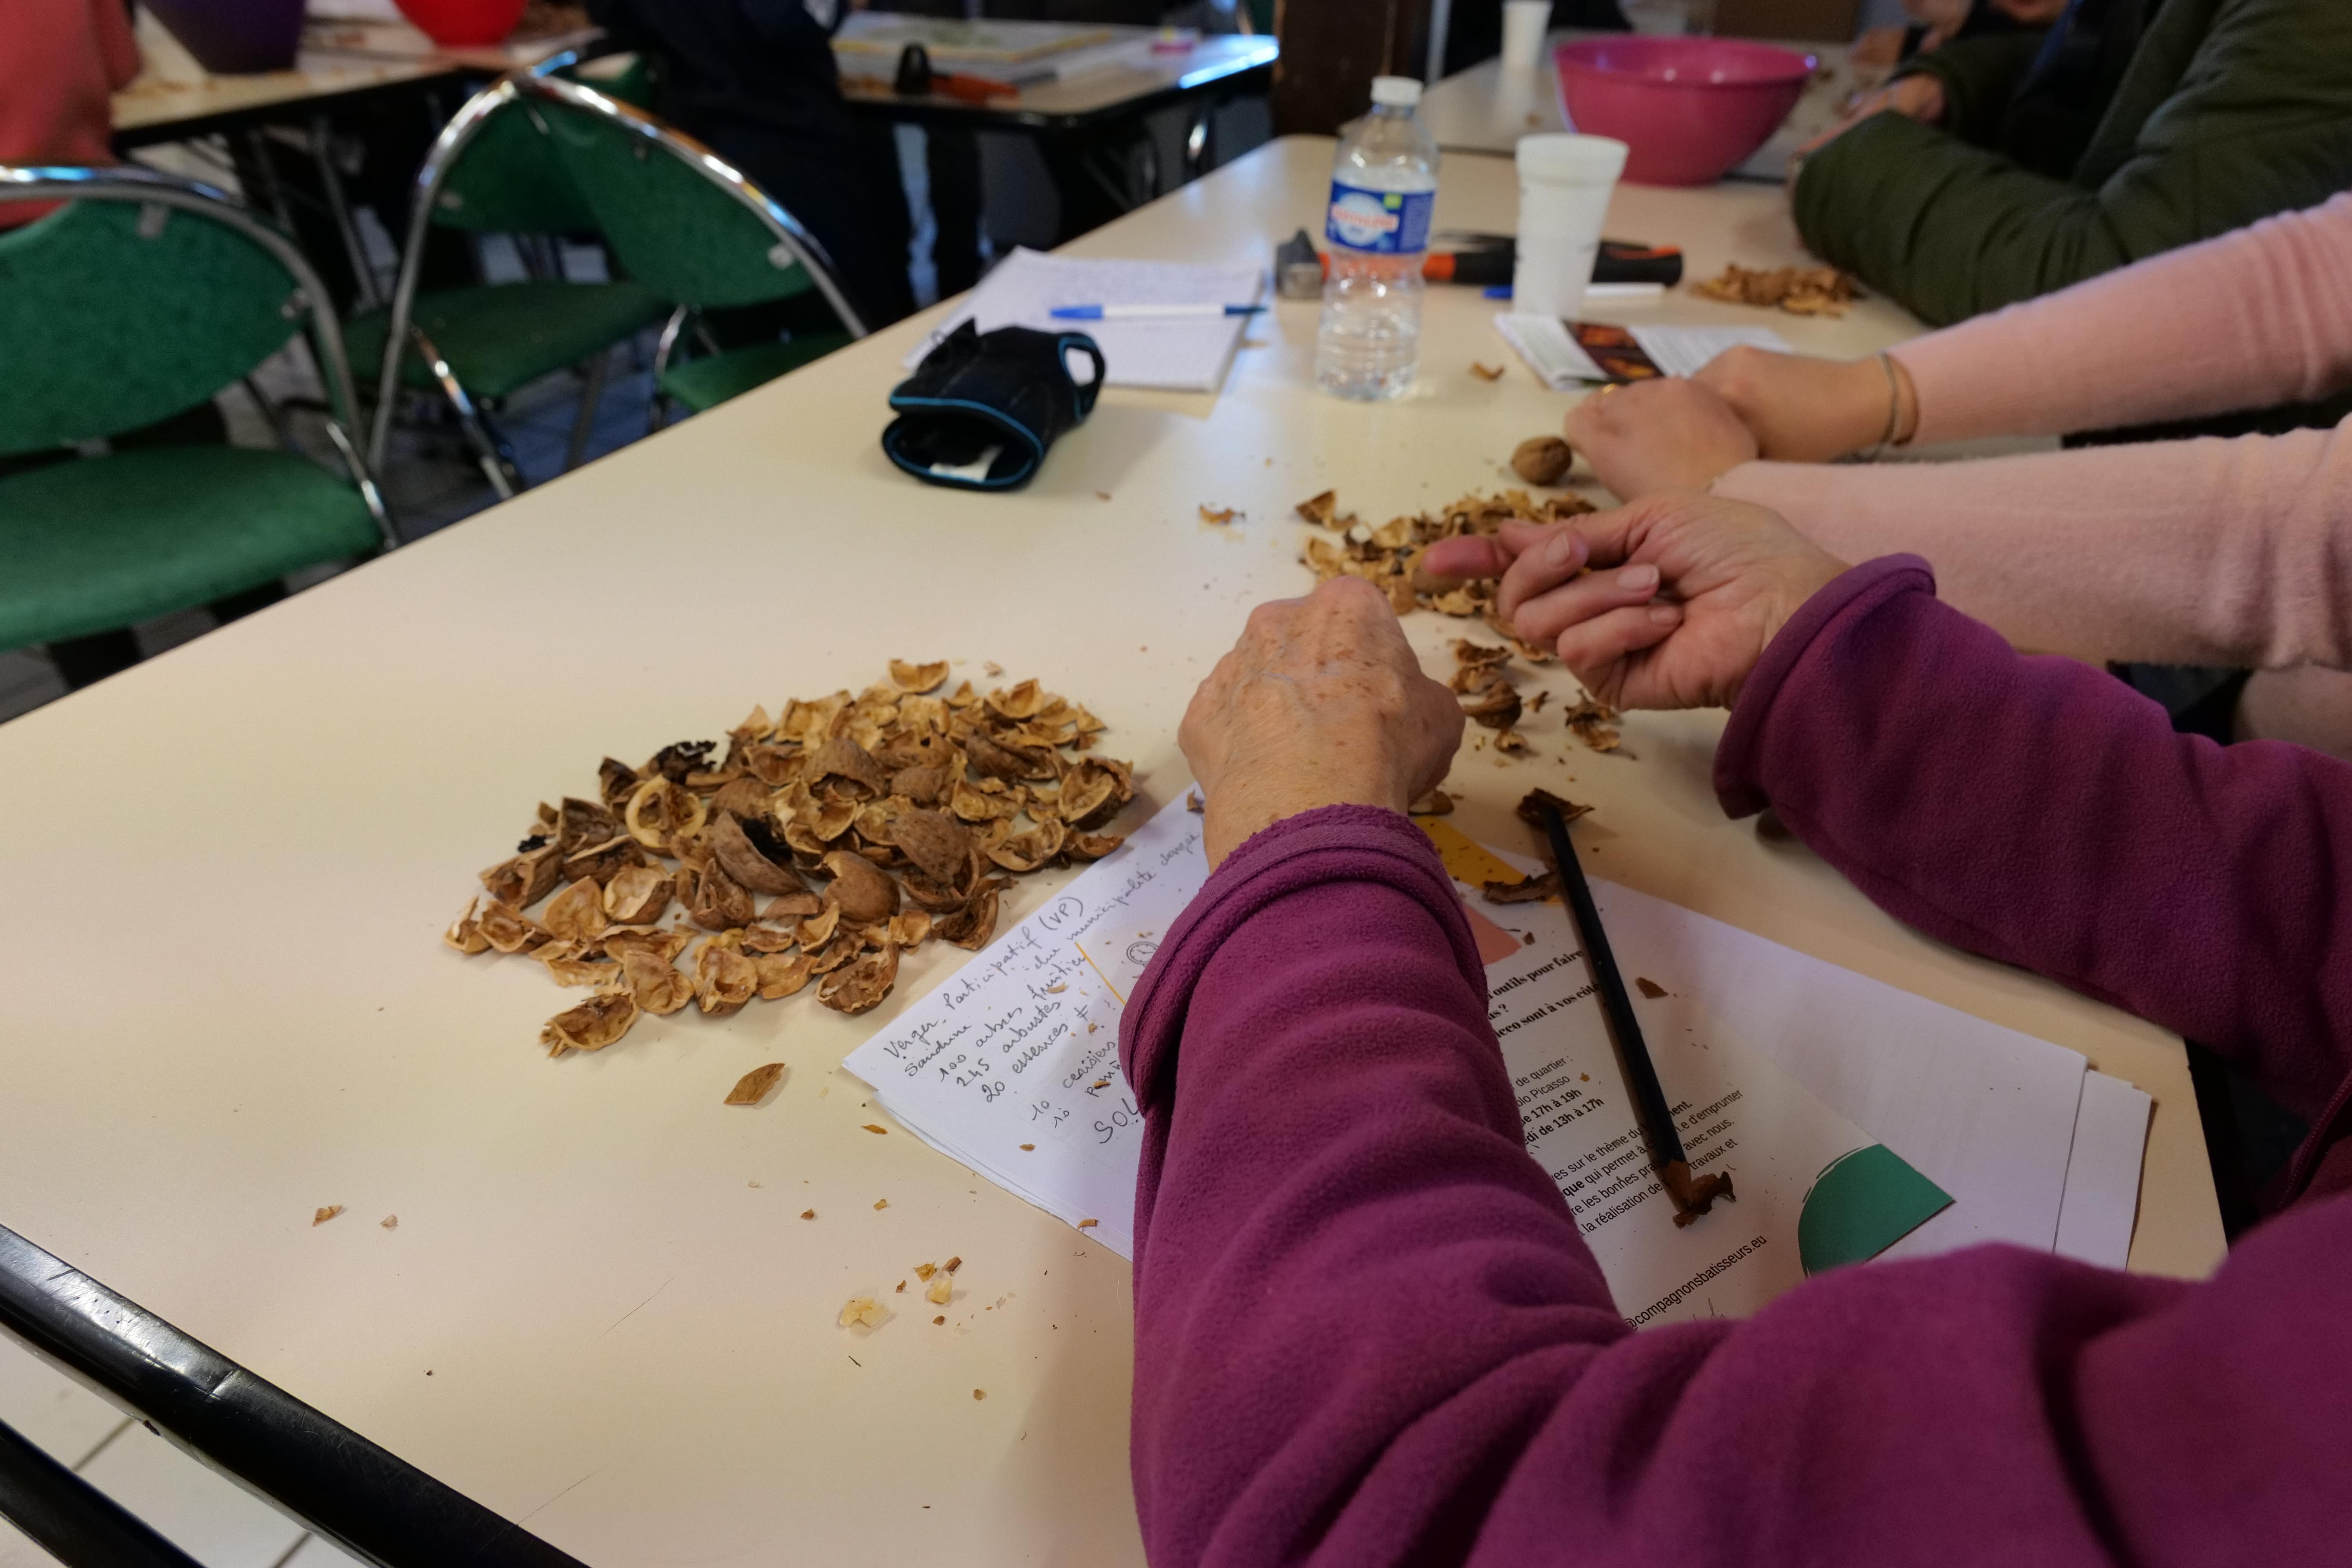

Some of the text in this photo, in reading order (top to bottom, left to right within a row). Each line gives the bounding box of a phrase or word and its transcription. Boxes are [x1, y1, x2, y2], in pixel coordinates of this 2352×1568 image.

[883, 897, 1083, 1058] Verger Participatif (VP)
[1493, 976, 1528, 996] outils
[1526, 963, 1555, 982] pour
[1553, 950, 1584, 966] faire
[1498, 1003, 1509, 1013] ?
[1520, 1007, 1549, 1025] sont
[1544, 1003, 1557, 1013] à
[1555, 995, 1577, 1008] vos
[904, 1025, 973, 1077] Sandrine
[940, 1054, 967, 1083] 100
[976, 1007, 1022, 1048] arbres
[956, 1001, 1061, 1087] 245 arbustes
[982, 1081, 1005, 1103] 20
[1012, 1023, 1069, 1074] essences
[1032, 1041, 1116, 1121] 10 cerisiers
[1515, 1076, 1530, 1087] de
[1530, 1058, 1566, 1080] quartier
[1530, 1076, 1570, 1098] Picasso
[1531, 1104, 1553, 1118] 17h
[1551, 1099, 1563, 1107] à
[1561, 1089, 1583, 1103] 19h
[1539, 1125, 1555, 1136] de
[1553, 1114, 1576, 1128] 13h
[1573, 1109, 1585, 1117] à
[1582, 1098, 1604, 1112] 17h
[1568, 1159, 1586, 1172] sur
[1583, 1153, 1597, 1163] le
[1595, 1136, 1629, 1156] thème
[1628, 1127, 1643, 1139] du
[1584, 1169, 1603, 1184] qui
[1601, 1150, 1639, 1176] permet
[1635, 1145, 1647, 1154] à
[1688, 1090, 1743, 1125] d'emprunter
[1581, 1195, 1601, 1208] les
[1598, 1173, 1639, 1199] bonnes
[1683, 1134, 1708, 1151] avec
[1706, 1119, 1735, 1137] nous.
[1581, 1223, 1597, 1233] la
[1595, 1191, 1649, 1226] réalisation
[1647, 1183, 1663, 1194] de
[1688, 1145, 1727, 1170] travaux
[1725, 1138, 1738, 1149] et
